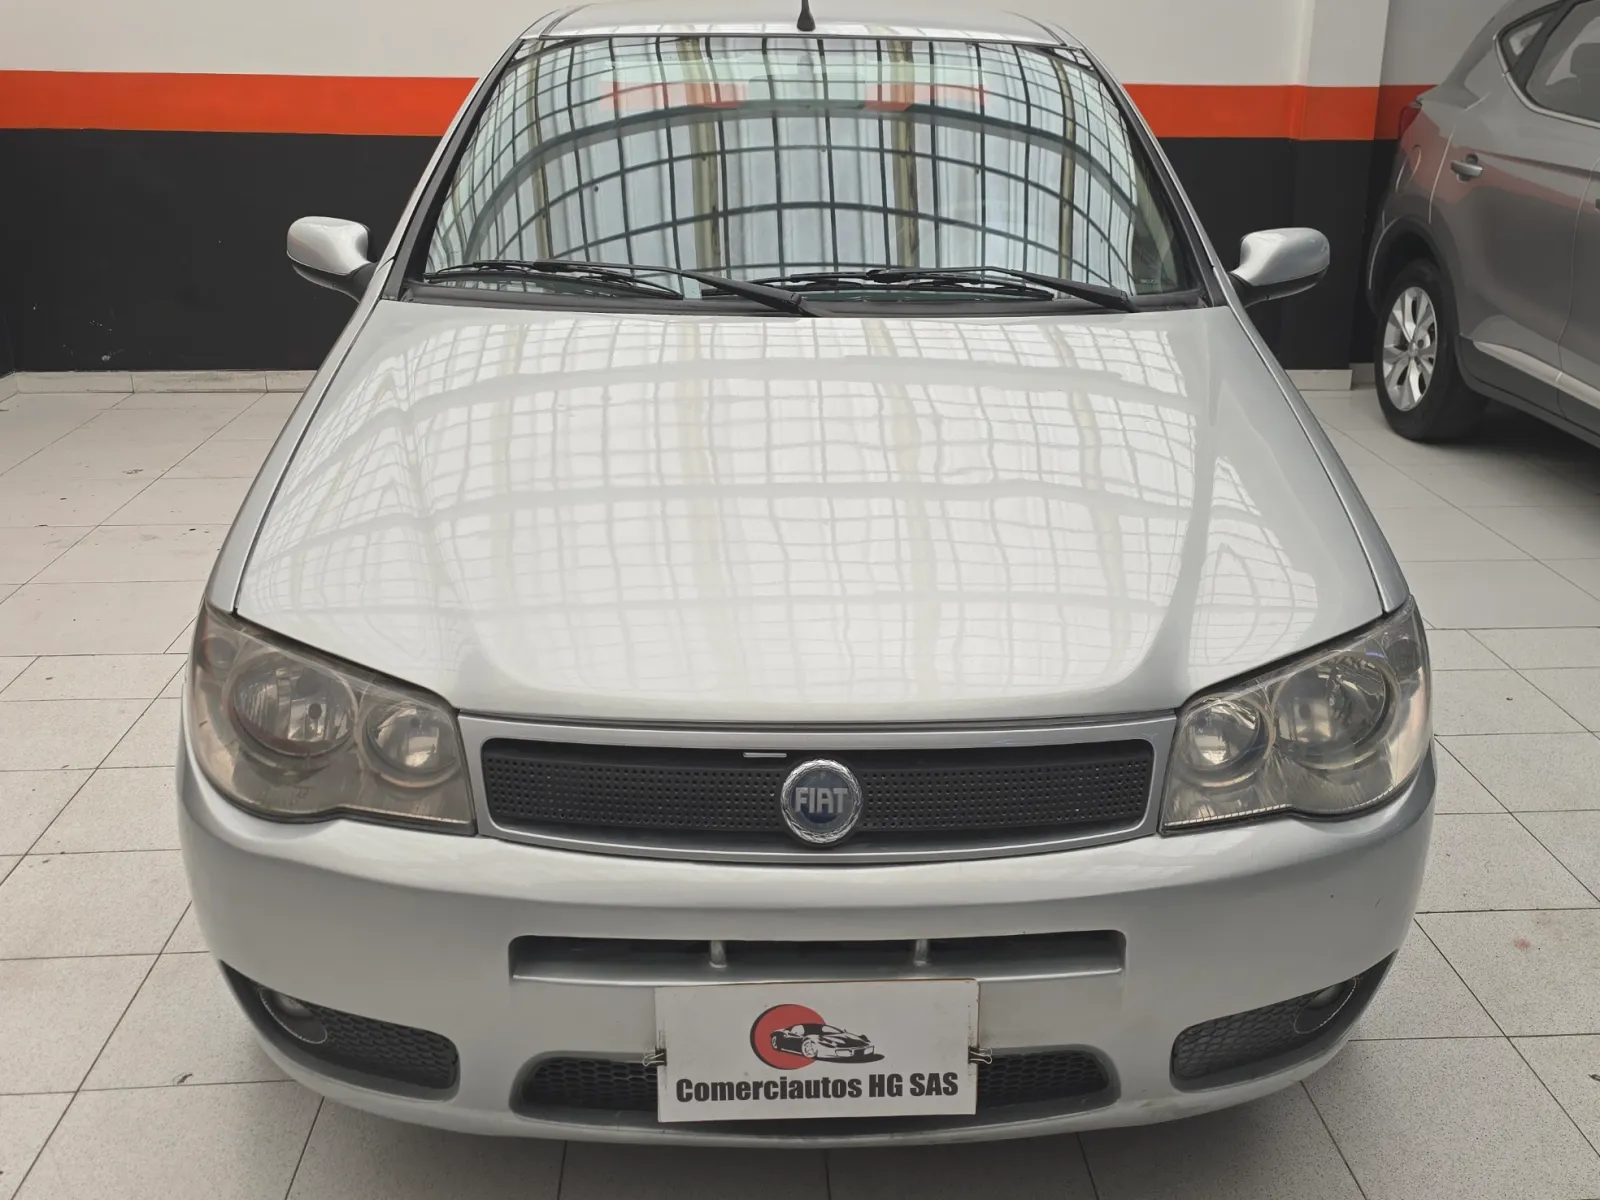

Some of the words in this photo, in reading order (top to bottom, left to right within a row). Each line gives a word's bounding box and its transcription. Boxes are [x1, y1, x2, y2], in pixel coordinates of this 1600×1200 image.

[794, 787, 848, 813] FIAT
[676, 1076, 863, 1102] Comerciautos
[869, 1073, 903, 1098] HG
[910, 1071, 959, 1096] SAS
